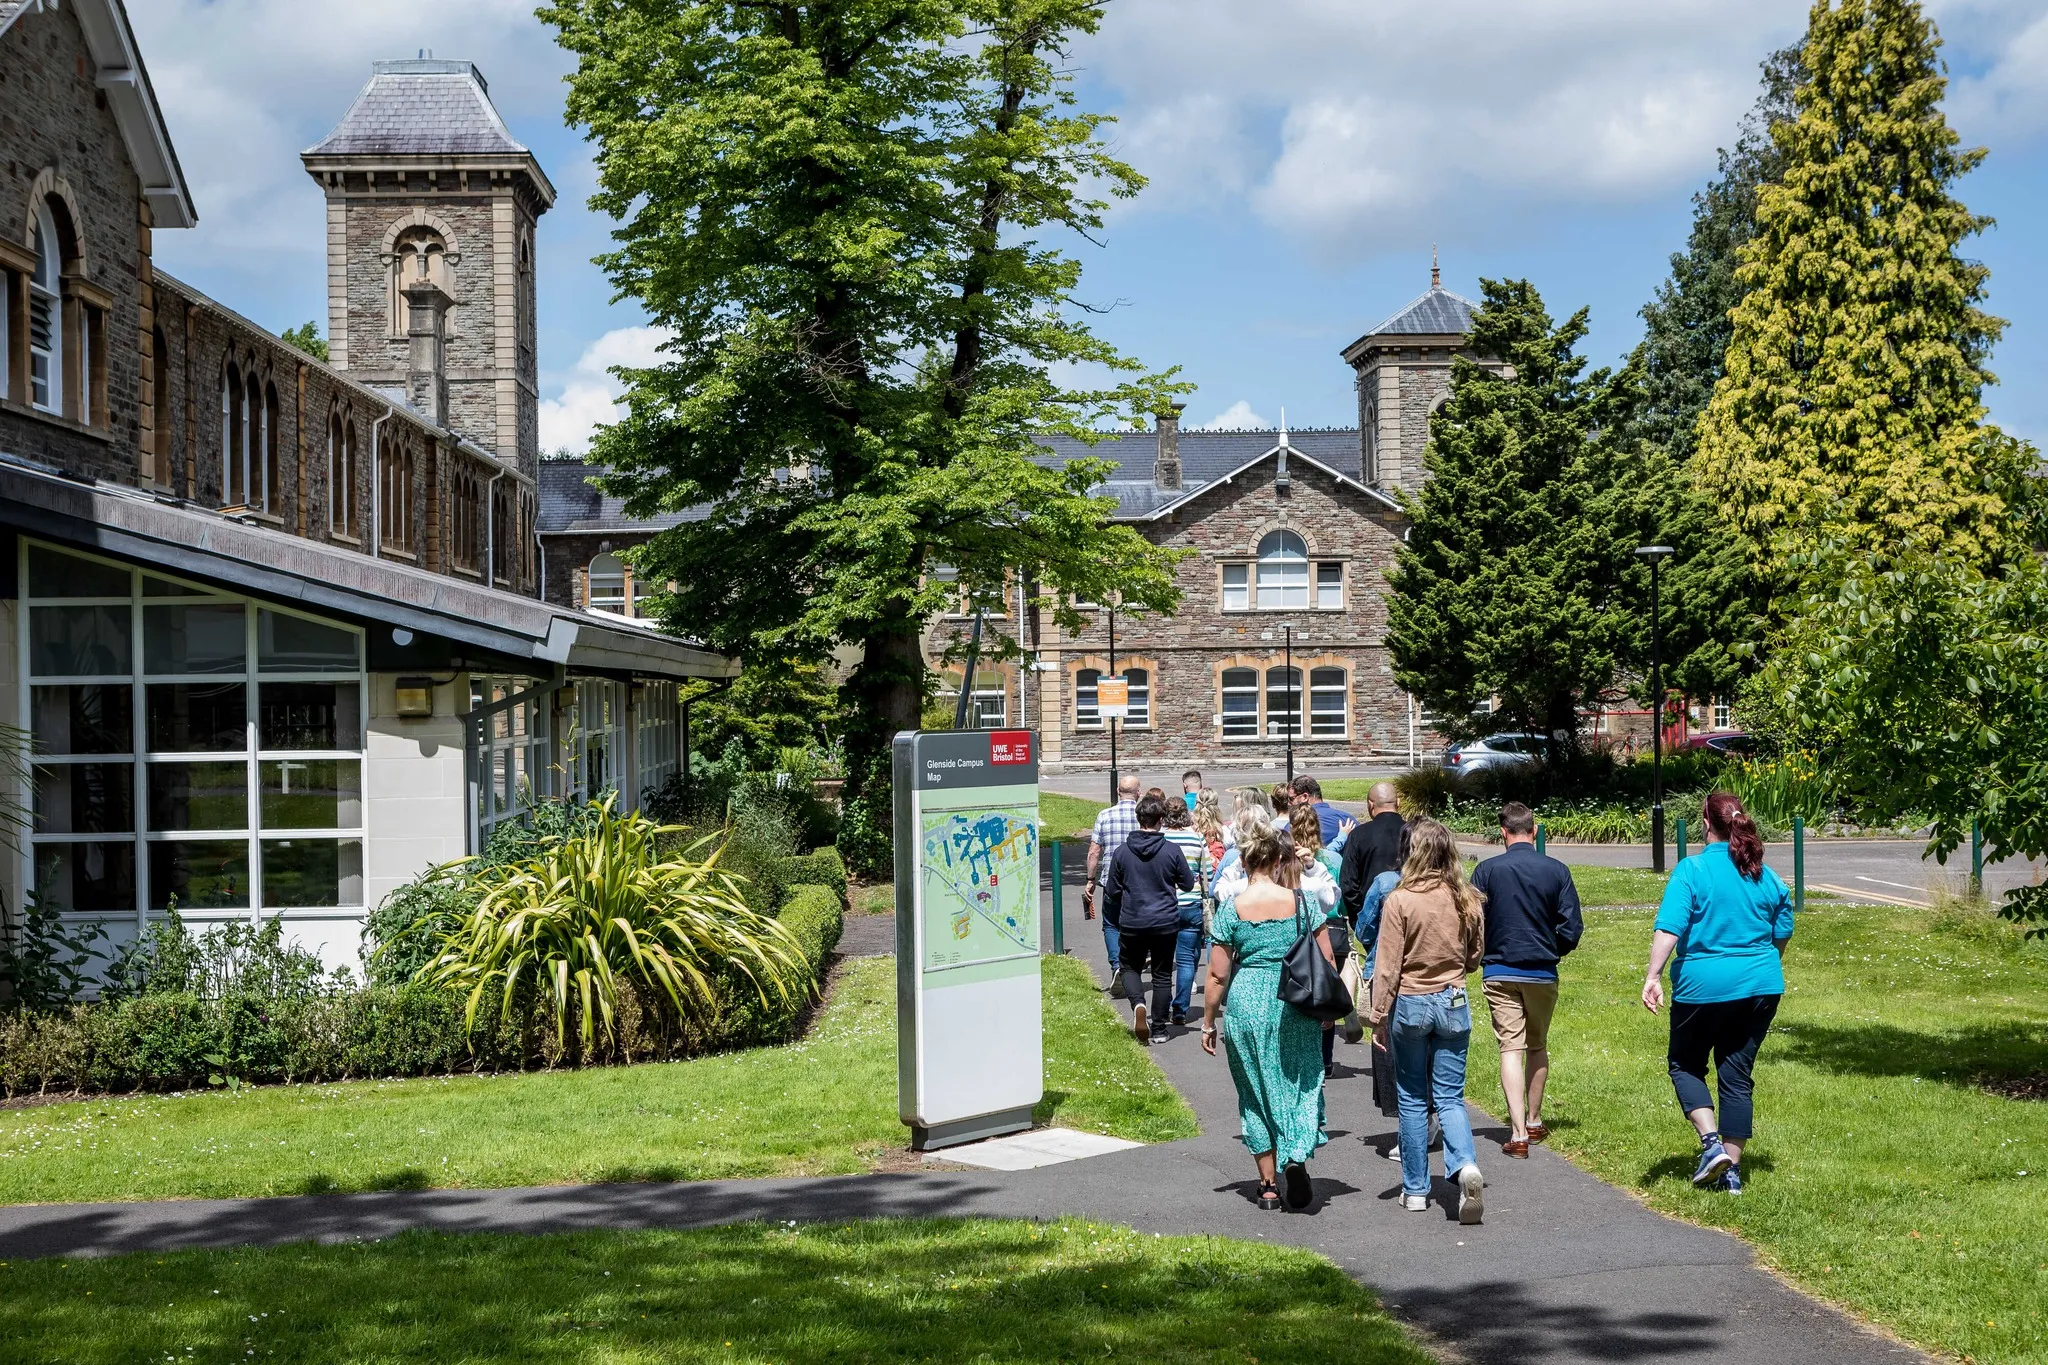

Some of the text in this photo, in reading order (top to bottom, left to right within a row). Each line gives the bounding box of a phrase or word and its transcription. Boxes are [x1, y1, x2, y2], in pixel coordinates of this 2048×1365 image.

[992, 744, 1008, 753] UWE
[992, 753, 1013, 762] Bristol
[926, 758, 984, 769] Glenside Campus
[927, 772, 942, 783] Map
